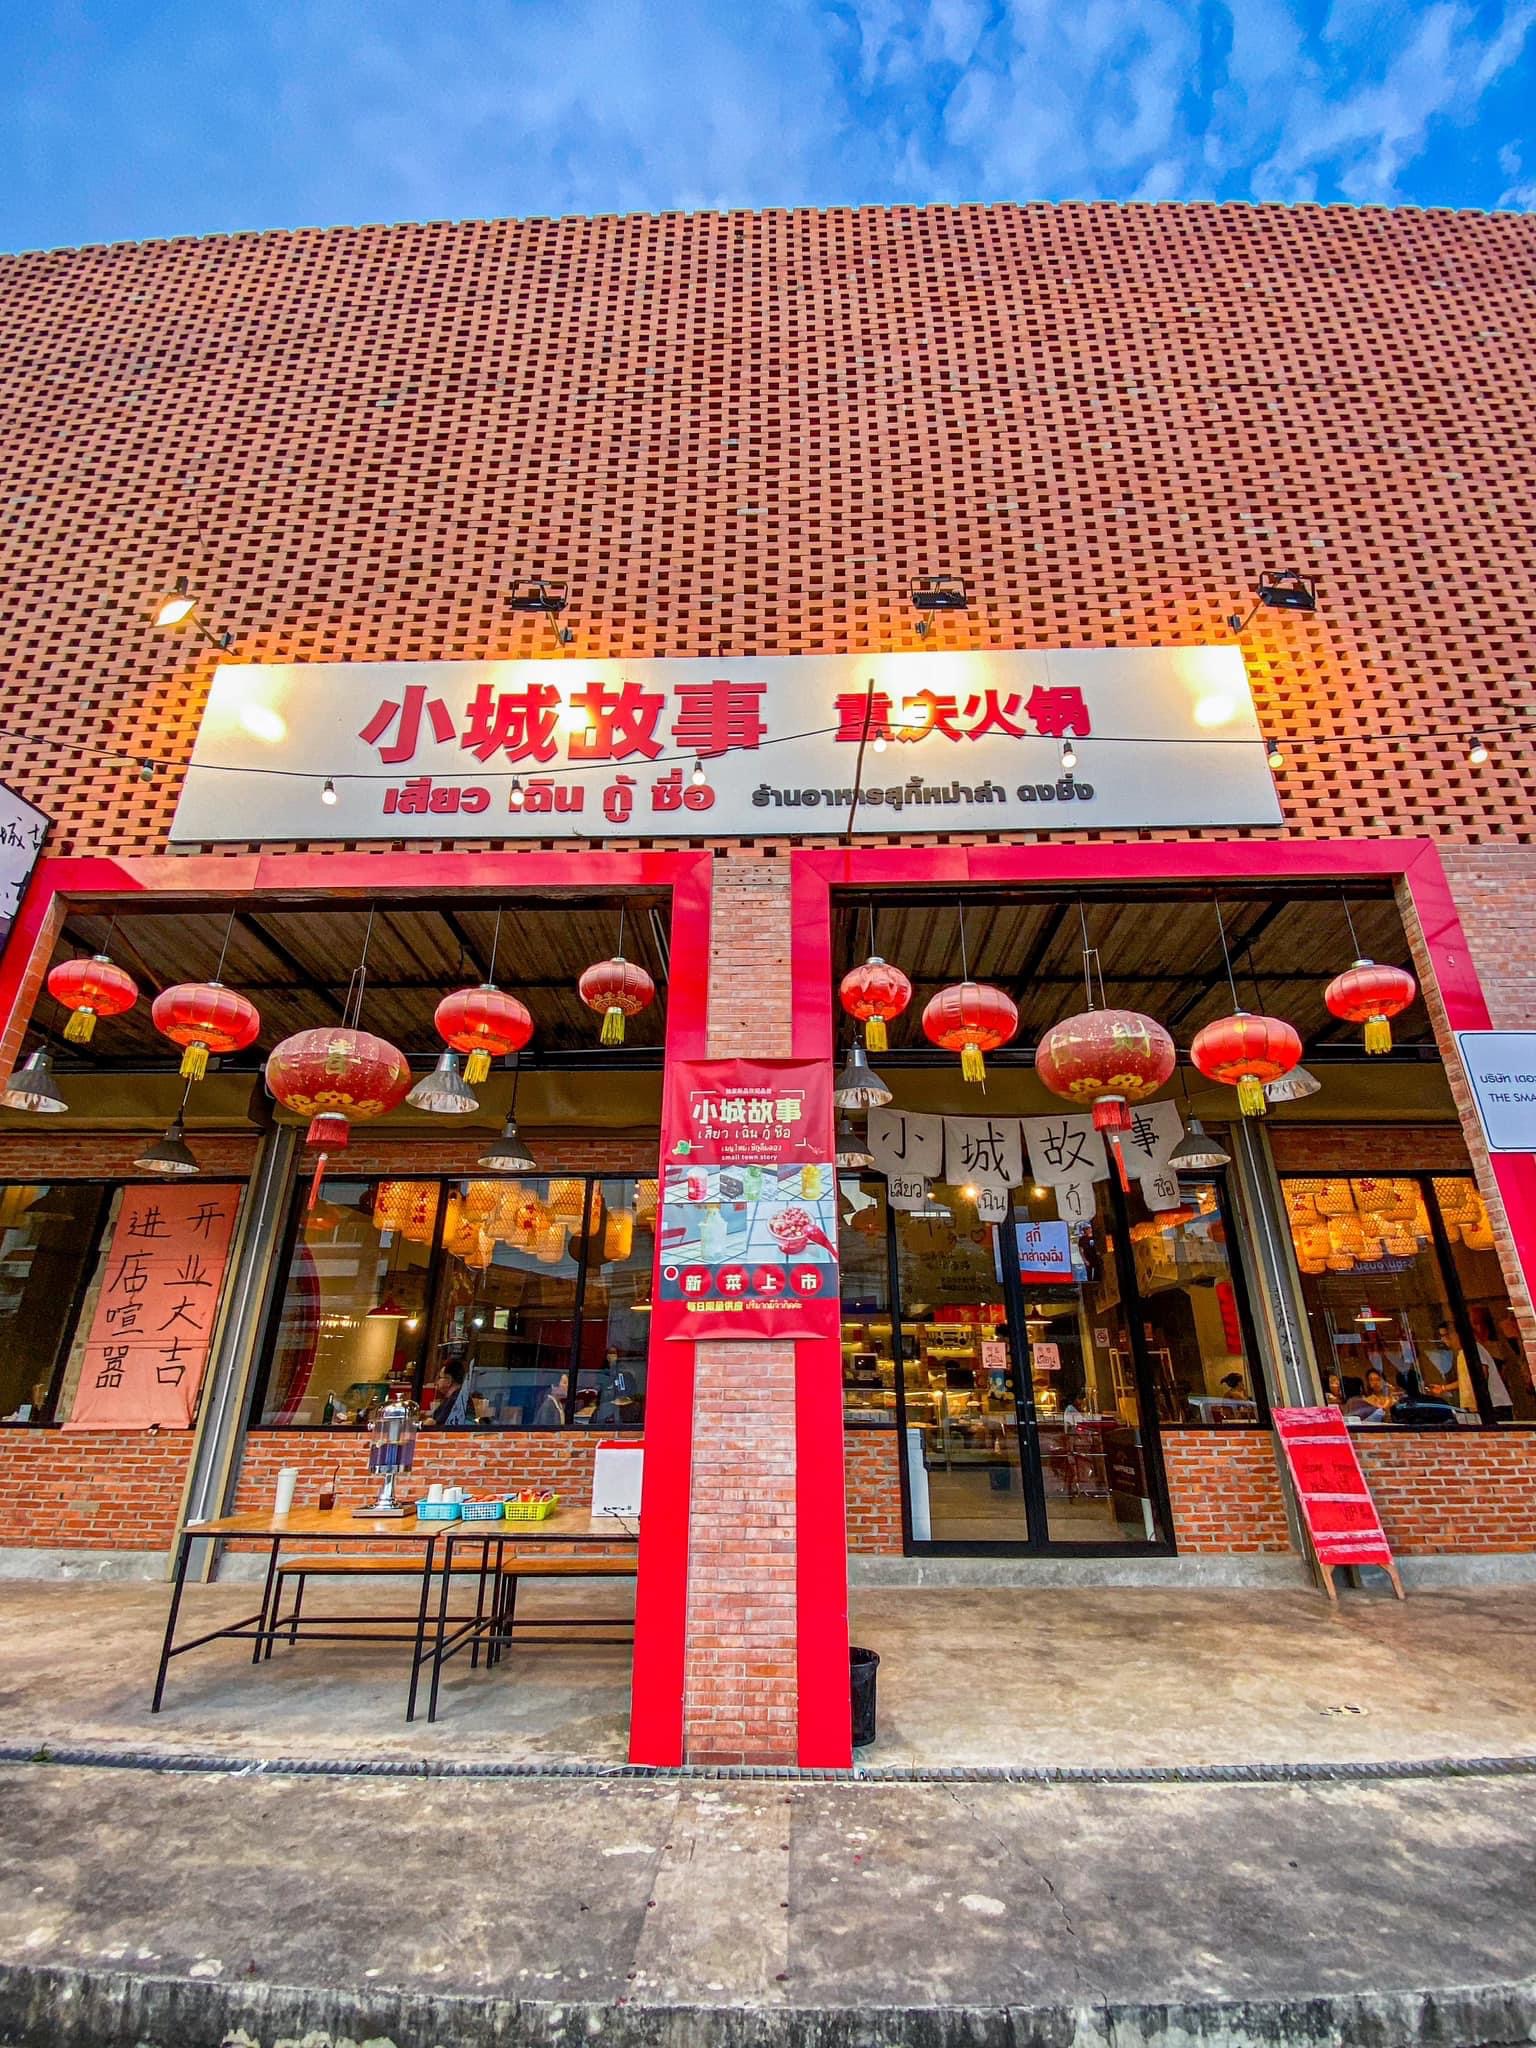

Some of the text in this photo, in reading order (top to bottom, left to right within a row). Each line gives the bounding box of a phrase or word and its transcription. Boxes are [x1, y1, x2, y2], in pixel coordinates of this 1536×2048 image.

[359, 680, 1091, 763] 小城故事 重庆火锅
[1480, 1073, 1536, 1083] บริษัท เดอ
[1488, 1093, 1511, 1102] THE
[692, 1098, 802, 1124] 小城故事
[882, 1111, 1160, 1182] 小城故事
[156, 1201, 226, 1387] 开业大吉
[685, 1273, 817, 1292] 新菜上市
